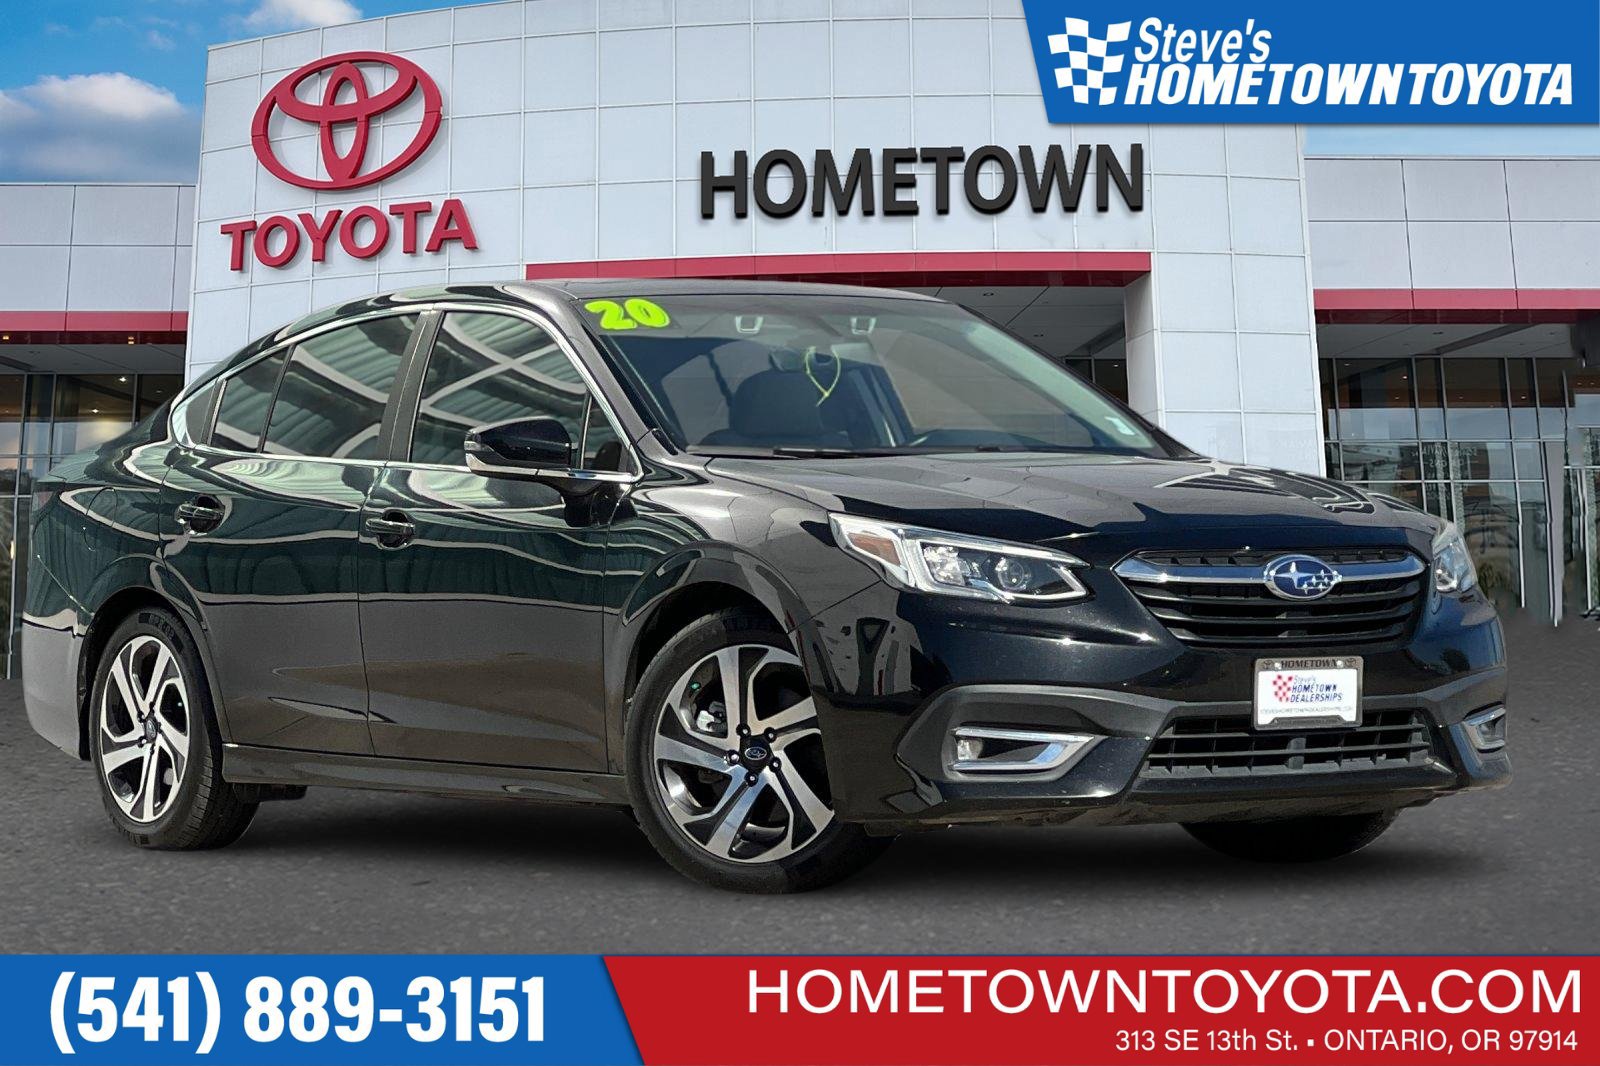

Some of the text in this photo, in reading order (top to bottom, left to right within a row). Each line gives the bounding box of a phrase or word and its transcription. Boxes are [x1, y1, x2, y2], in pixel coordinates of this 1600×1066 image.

[699, 143, 1145, 220] HOMETOWN
[221, 199, 478, 271] TOYOTA
[584, 297, 671, 331] 20
[1281, 659, 1338, 669] HOMETOWN
[1294, 675, 1316, 684] Steve's
[1292, 684, 1338, 692] HOMETOWN
[1290, 693, 1343, 703] DEALERSHIPS
